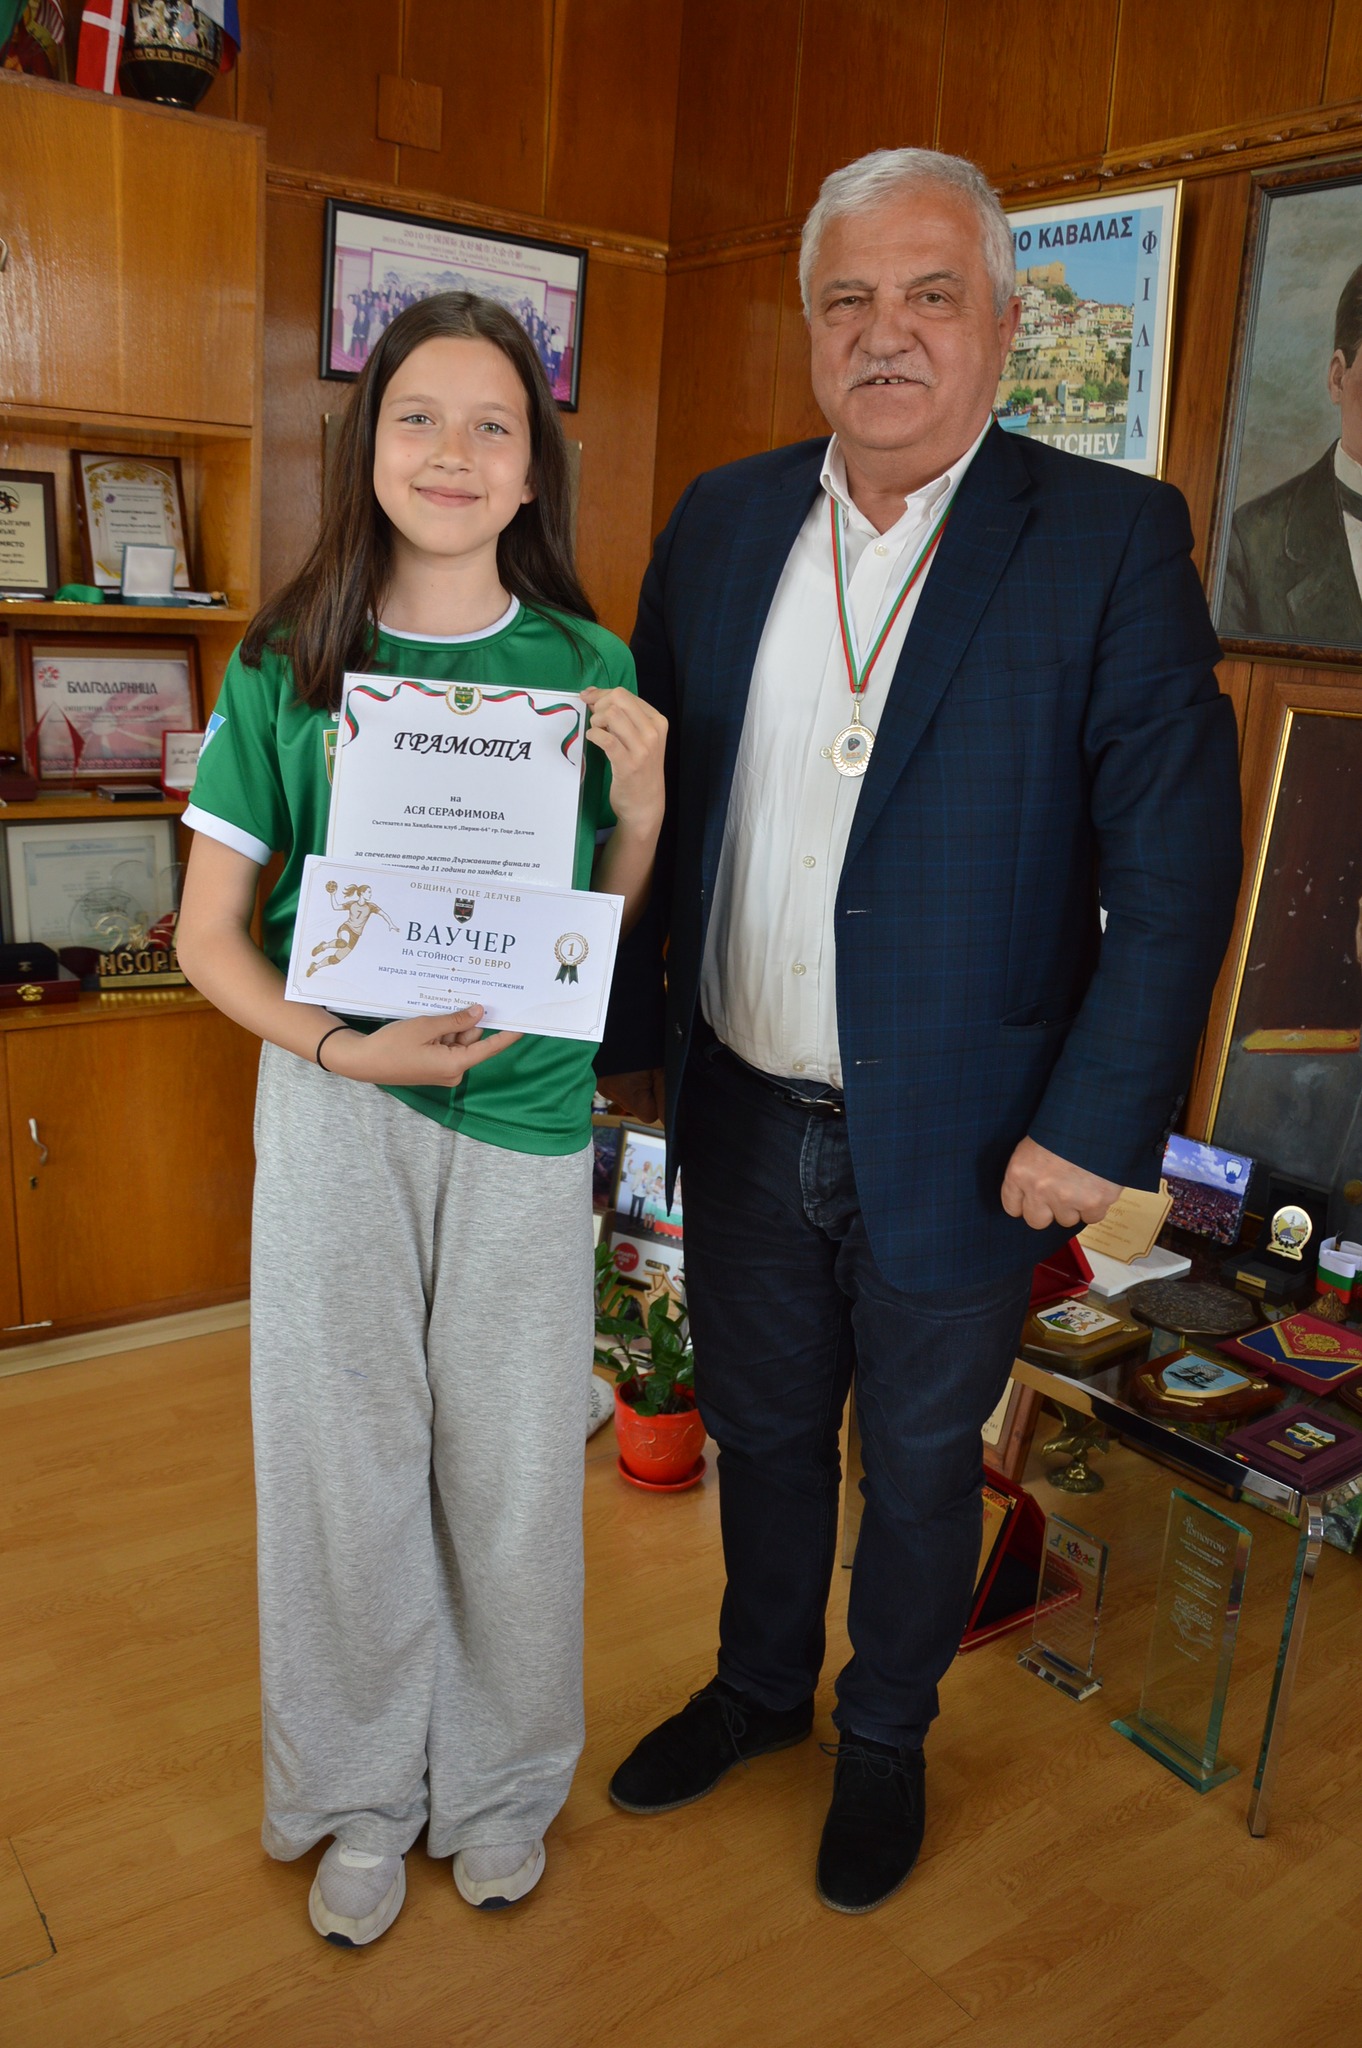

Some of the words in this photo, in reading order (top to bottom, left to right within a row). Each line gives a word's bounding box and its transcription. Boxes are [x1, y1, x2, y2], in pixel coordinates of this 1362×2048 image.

[1038, 216, 1133, 249] ΚΑΒΑΛΑΣ
[1031, 432, 1119, 455] TCHEV
[67, 681, 158, 695] БЛАГОДАРНИЦА
[394, 732, 532, 761] ГРАМОТА
[450, 794, 462, 803] на
[404, 805, 426, 815] АСЯ
[428, 807, 505, 821] СЕРАФИМОВА
[372, 819, 403, 827] Състезател
[412, 822, 443, 831] Хандбален
[443, 824, 458, 832] клуб
[364, 851, 401, 859] спечелено
[401, 854, 425, 862] второ
[425, 855, 451, 863] място
[451, 856, 501, 865] Държавните
[502, 859, 531, 868] финали
[440, 866, 466, 874] години
[477, 868, 507, 877] хандбал
[410, 881, 452, 893] ОБЩИНА
[456, 887, 481, 898] ГОЦЕ
[483, 891, 521, 903] ДЕЛЧЕВ
[406, 921, 516, 954] ВАУЧЕР
[567, 942, 575, 957] 1
[401, 948, 414, 956] НА
[416, 950, 464, 963] СТОЙНОСТ
[467, 956, 482, 966] 50
[484, 958, 511, 969] ЕВРО
[378, 965, 408, 976] награда
[418, 971, 449, 981] отлични
[450, 976, 480, 986] спортни
[481, 979, 525, 991] постижения
[419, 992, 452, 1003] Владимир
